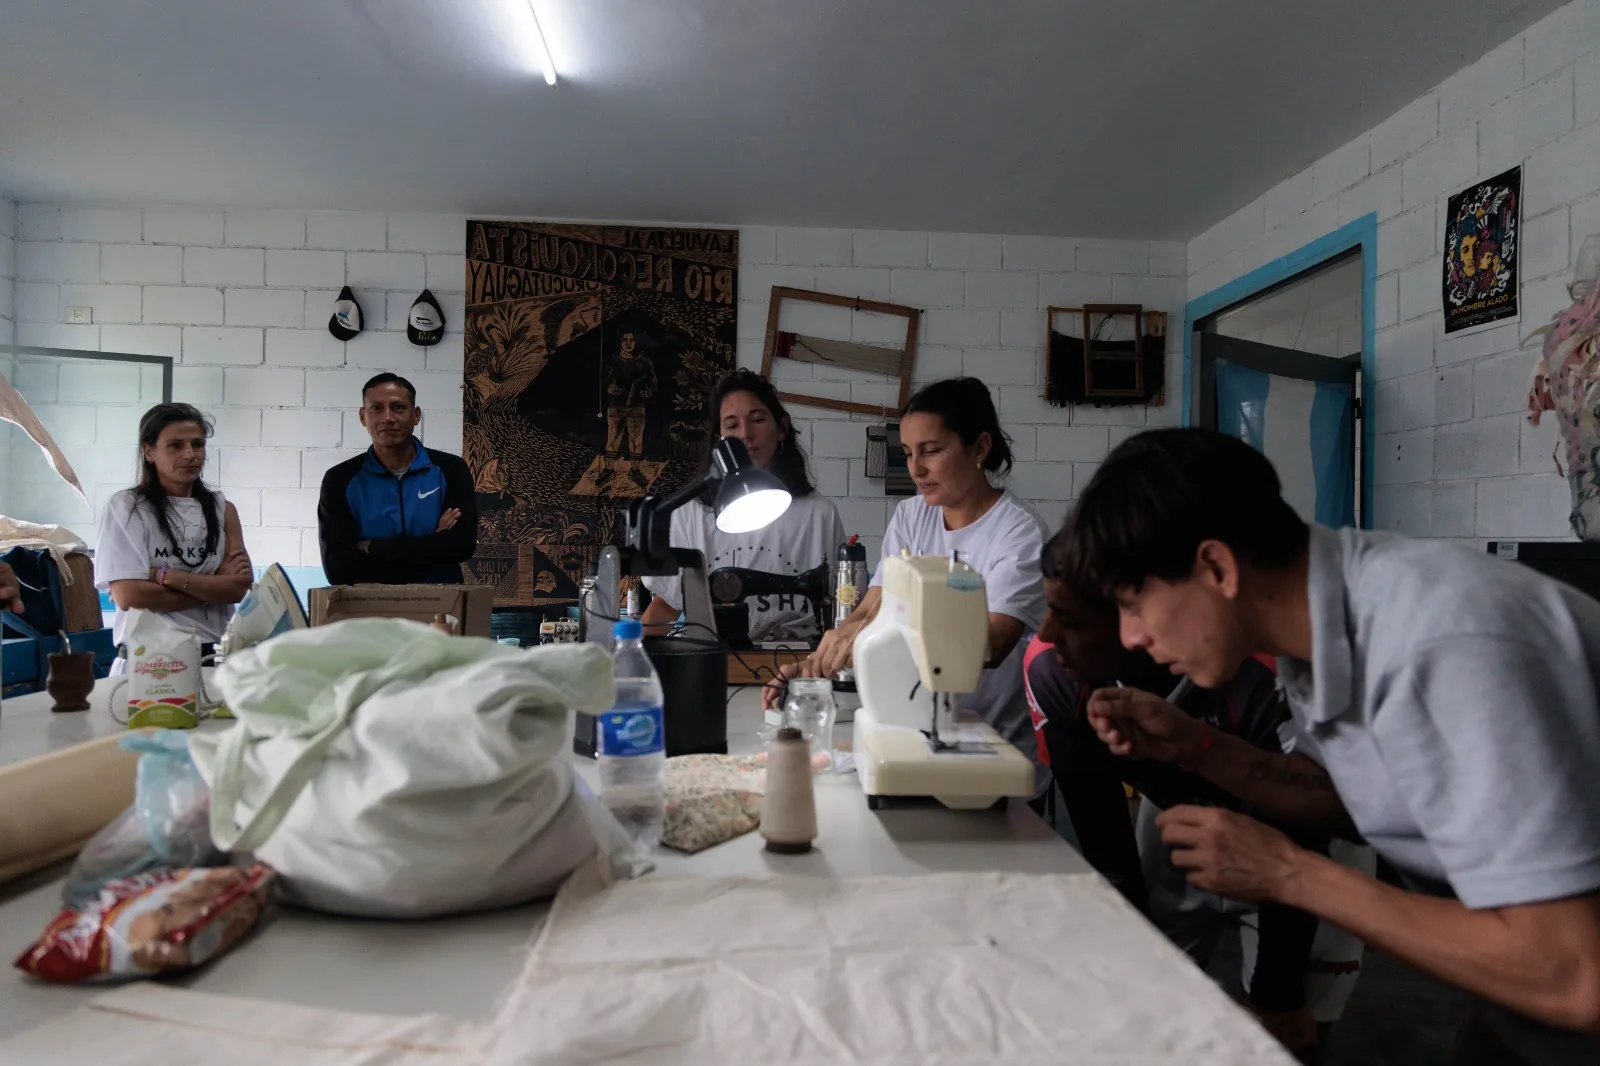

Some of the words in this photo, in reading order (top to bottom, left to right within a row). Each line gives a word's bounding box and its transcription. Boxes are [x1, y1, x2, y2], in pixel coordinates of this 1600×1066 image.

[1450, 308, 1459, 316] UN
[1459, 300, 1486, 313] HOMBRE
[1487, 294, 1509, 306] ALADO
